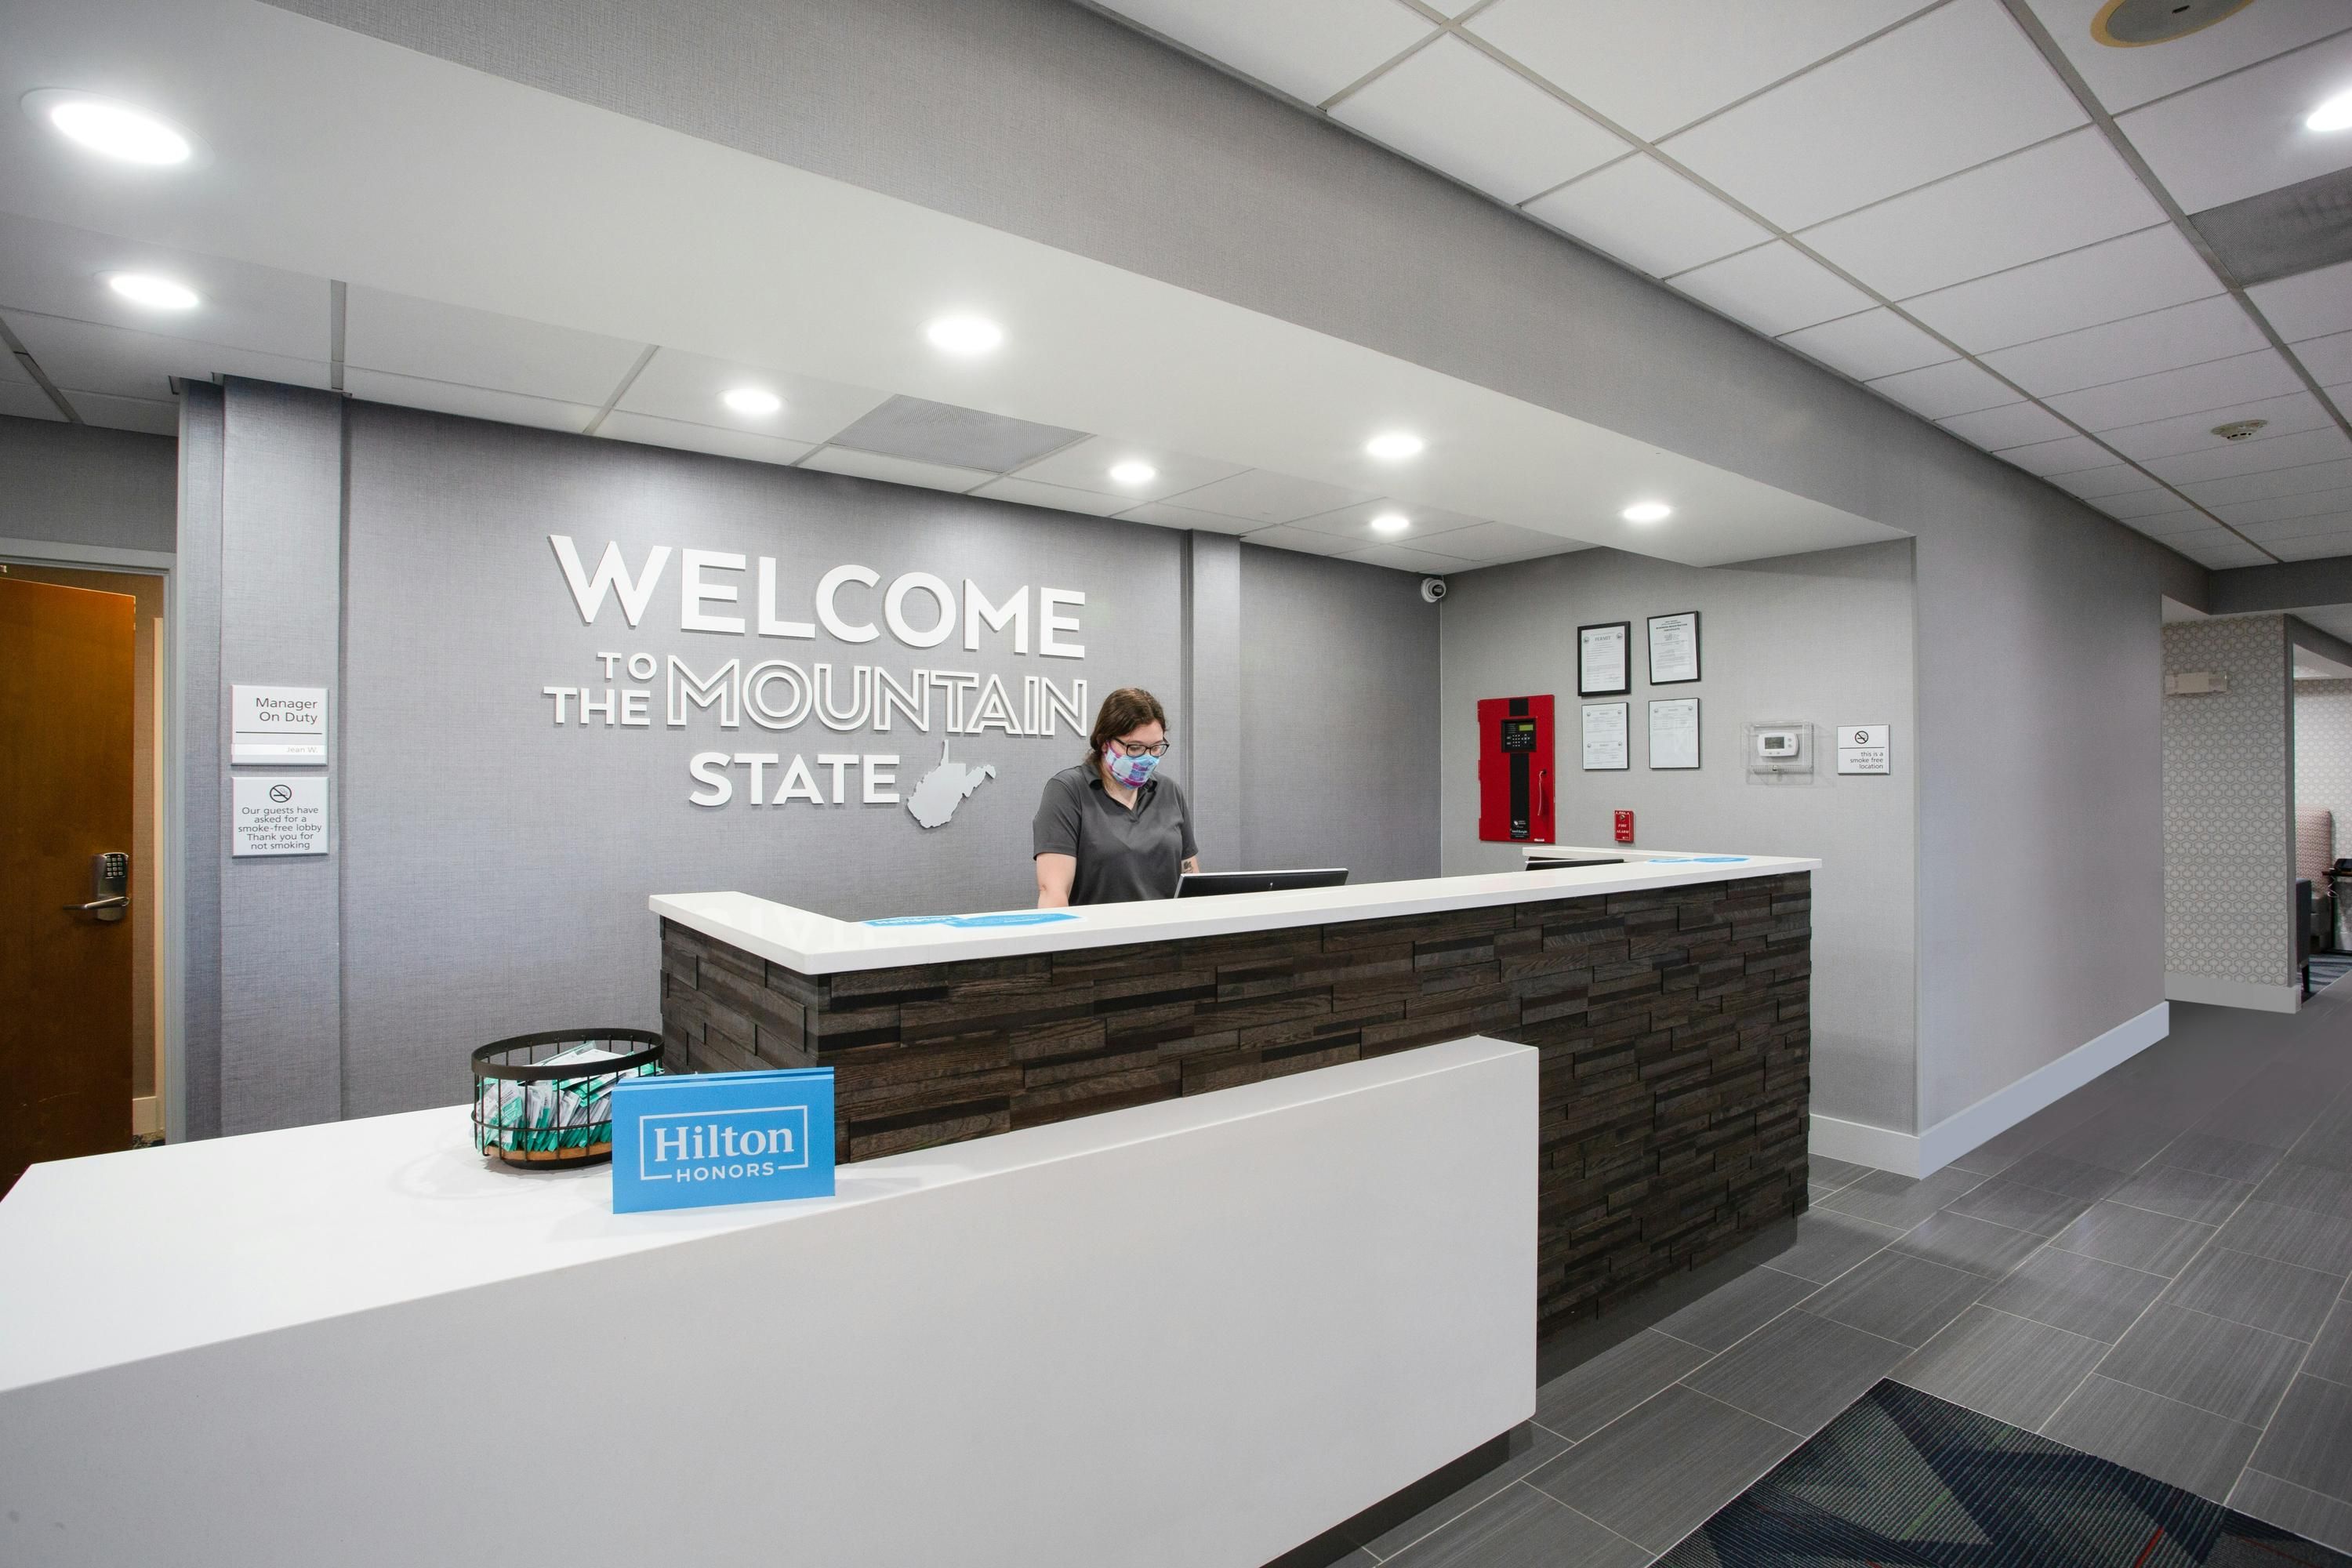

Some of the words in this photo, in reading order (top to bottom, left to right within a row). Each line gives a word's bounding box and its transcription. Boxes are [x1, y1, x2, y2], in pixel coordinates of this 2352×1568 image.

[549, 535, 1086, 659] WELCOME
[597, 652, 657, 680] TO
[256, 697, 318, 710] Manager
[543, 686, 651, 726] THE
[667, 655, 1087, 736] MOUNTAIN
[260, 711, 280, 721] On
[285, 712, 318, 724] Duty
[689, 751, 901, 807] STATE
[296, 823, 322, 833] lobby
[270, 841, 310, 850] smoking
[654, 1124, 794, 1162] Hilton
[677, 1162, 775, 1182] HONORS
